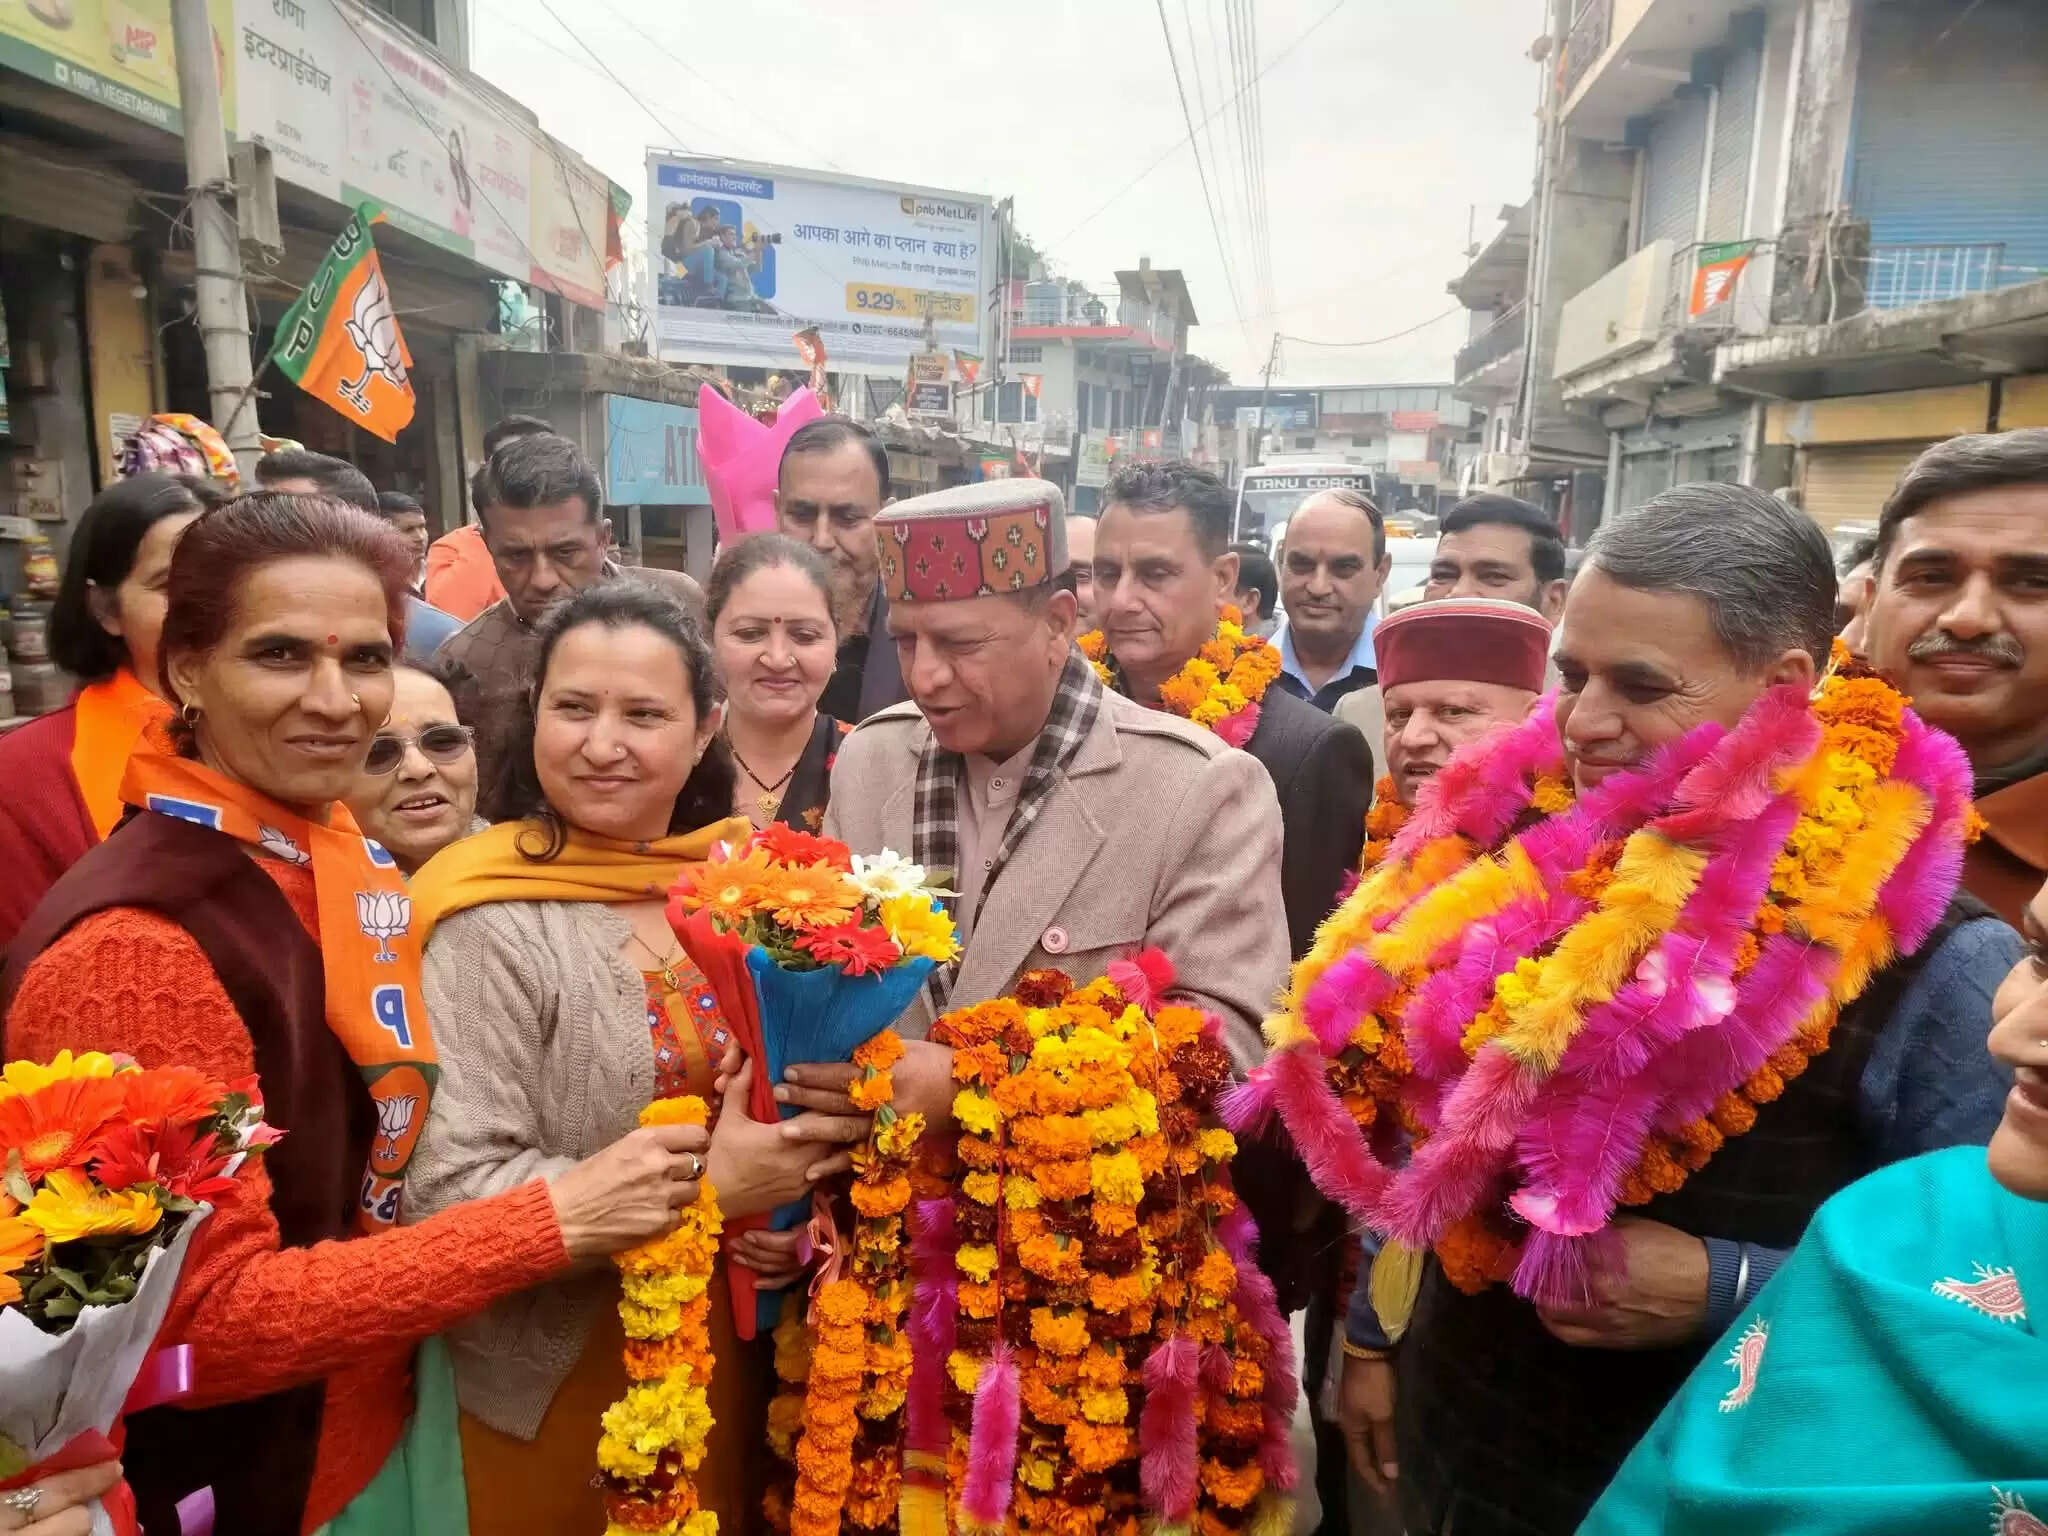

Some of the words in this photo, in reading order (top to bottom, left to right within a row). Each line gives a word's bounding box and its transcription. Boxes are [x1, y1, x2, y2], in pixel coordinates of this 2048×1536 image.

[102, 83, 169, 123] VEGETARIAN
[916, 202, 936, 216] pnb
[936, 208, 977, 222] MetLife
[793, 223, 839, 243] आपका
[844, 228, 871, 248] आगे
[874, 233, 891, 249] का
[894, 236, 926, 255] प्लान
[933, 241, 957, 258] क्या
[285, 214, 362, 361] BJP
[1254, 477, 1300, 489] TANU
[1306, 477, 1364, 490] COACH
